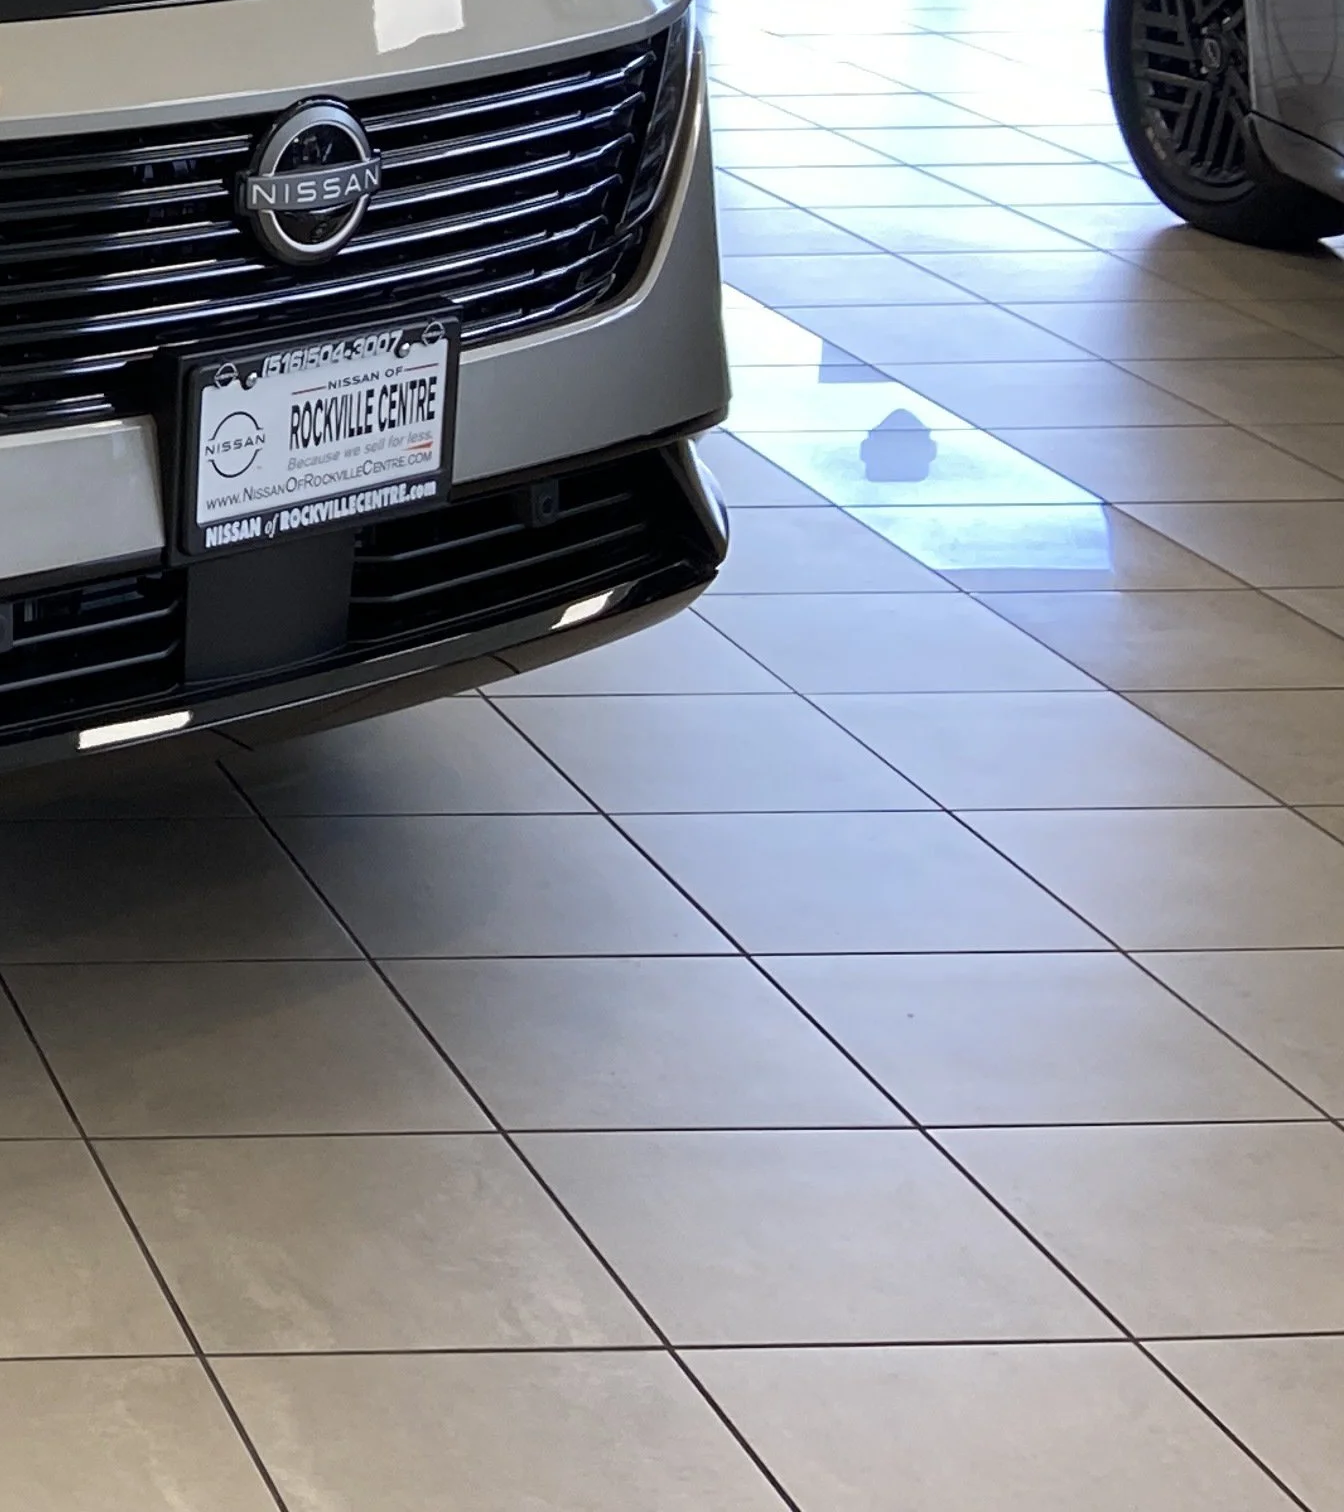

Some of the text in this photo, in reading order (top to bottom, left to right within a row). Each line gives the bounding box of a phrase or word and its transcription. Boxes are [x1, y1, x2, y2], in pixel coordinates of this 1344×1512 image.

[251, 164, 379, 205] NISSAN
[327, 365, 404, 391] NISSAN OF
[289, 375, 438, 451] ROCKVILLE CENTRE
[205, 434, 266, 457] NISSAN
[287, 451, 341, 472] Because
[343, 445, 361, 458] we
[364, 438, 385, 455] sell
[388, 434, 406, 450] for
[205, 480, 437, 549] NISSAN of ROCKVILLECENTRE.com
